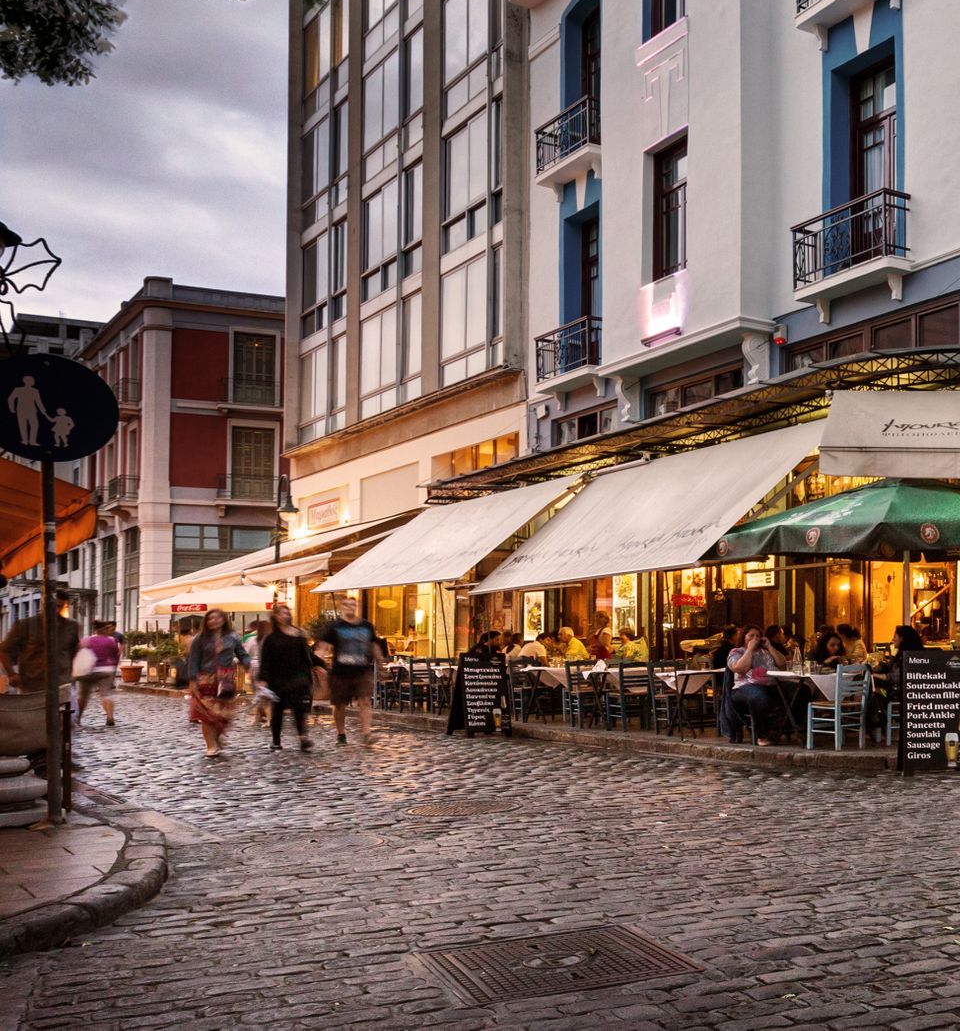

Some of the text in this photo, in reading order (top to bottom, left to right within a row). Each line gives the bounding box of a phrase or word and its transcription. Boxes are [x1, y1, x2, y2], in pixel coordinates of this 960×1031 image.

[909, 657, 930, 665] Menu
[906, 672, 947, 680] Biftekaki
[906, 682, 960, 690] Soutzoukaki
[906, 692, 942, 700] Chicken
[929, 711, 956, 719] Ankle
[907, 721, 946, 729] Pancetta
[907, 741, 941, 750] Sausage
[907, 752, 931, 760] Giros
